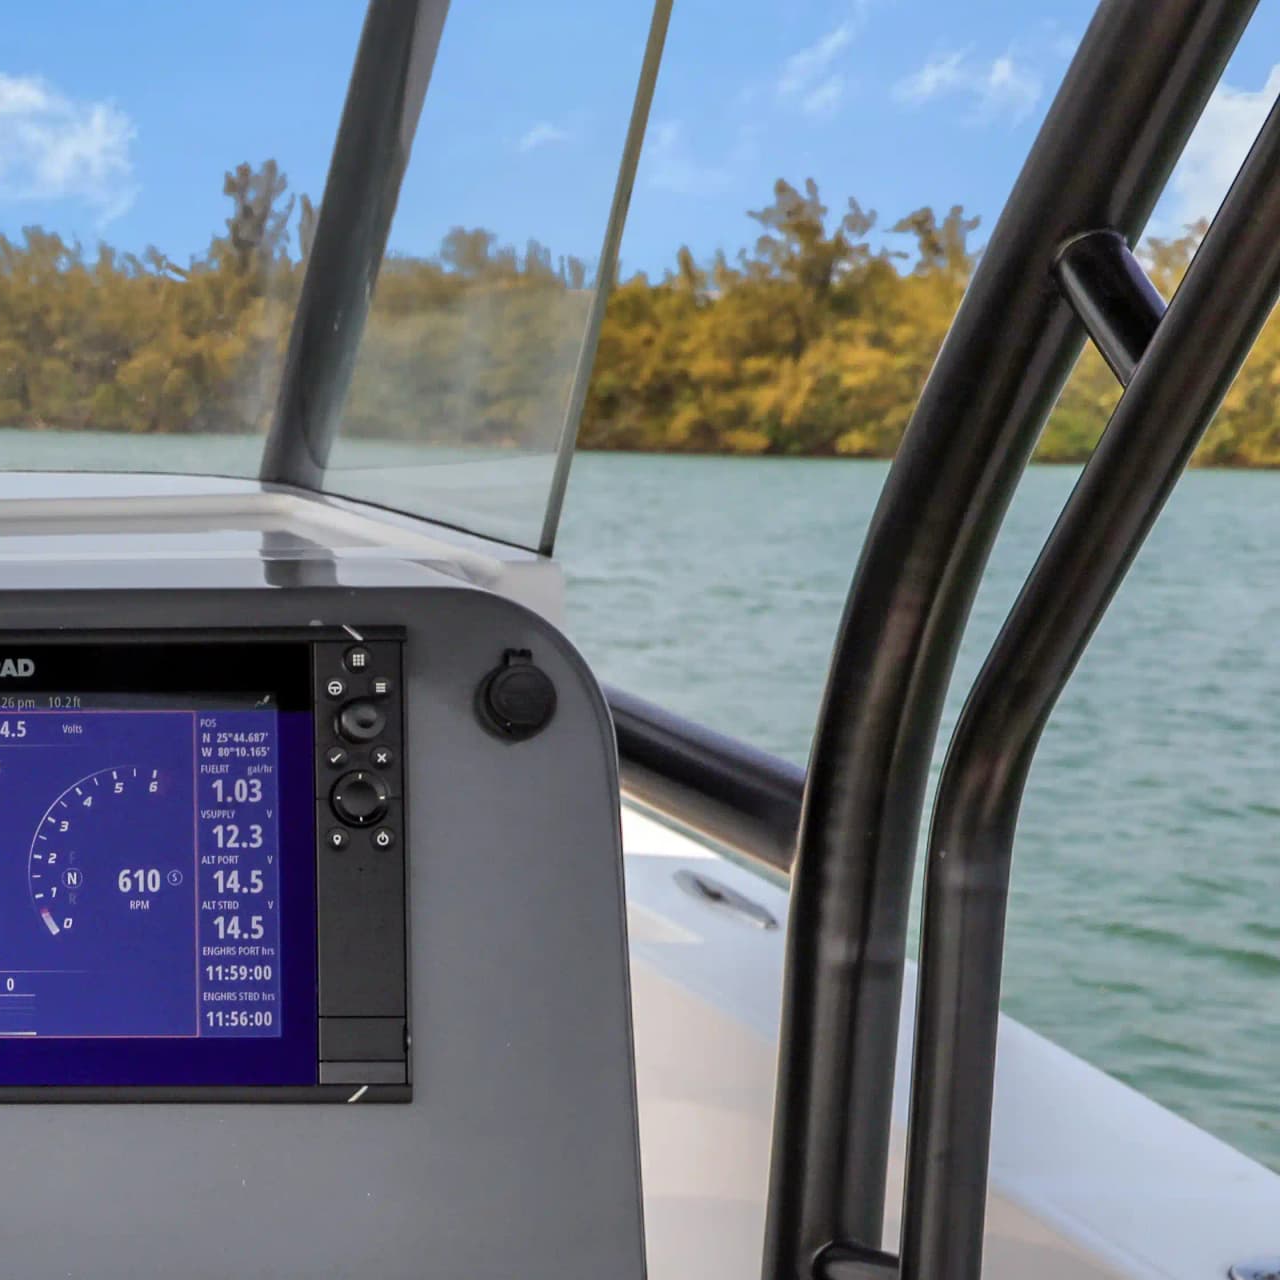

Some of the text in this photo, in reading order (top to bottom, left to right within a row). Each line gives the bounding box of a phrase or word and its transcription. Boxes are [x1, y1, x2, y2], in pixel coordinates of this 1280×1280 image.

[17, 699, 36, 713] pm
[200, 718, 217, 728] POS
[61, 724, 83, 735] Volts
[202, 733, 211, 743] N
[201, 747, 213, 757] W
[247, 764, 273, 776] gal/hr
[113, 782, 124, 793] 5
[148, 781, 159, 792] 6
[211, 778, 263, 803] 1.03
[82, 796, 93, 807] 4
[200, 809, 236, 819] VSUPPLY
[266, 810, 273, 819] V
[59, 821, 70, 832] 3
[211, 824, 264, 848] 12.3
[47, 853, 57, 864] 2
[201, 855, 239, 865] ALT PORT
[267, 855, 273, 865] V
[118, 868, 161, 893] 610
[212, 869, 264, 894] 14.5
[50, 887, 58, 898] 1
[129, 900, 150, 911] RPM
[201, 901, 240, 910] ALT STBD
[267, 901, 274, 910] V
[63, 917, 73, 929] 0
[213, 915, 264, 939] 14.5
[202, 946, 276, 956] ENGHRS PORT hrs
[206, 965, 272, 981] 11:59:00
[6, 977, 15, 991] 0
[203, 991, 238, 1001] ENGHRS
[262, 991, 276, 1001] hrs
[206, 1011, 273, 1027] 11:56:00
